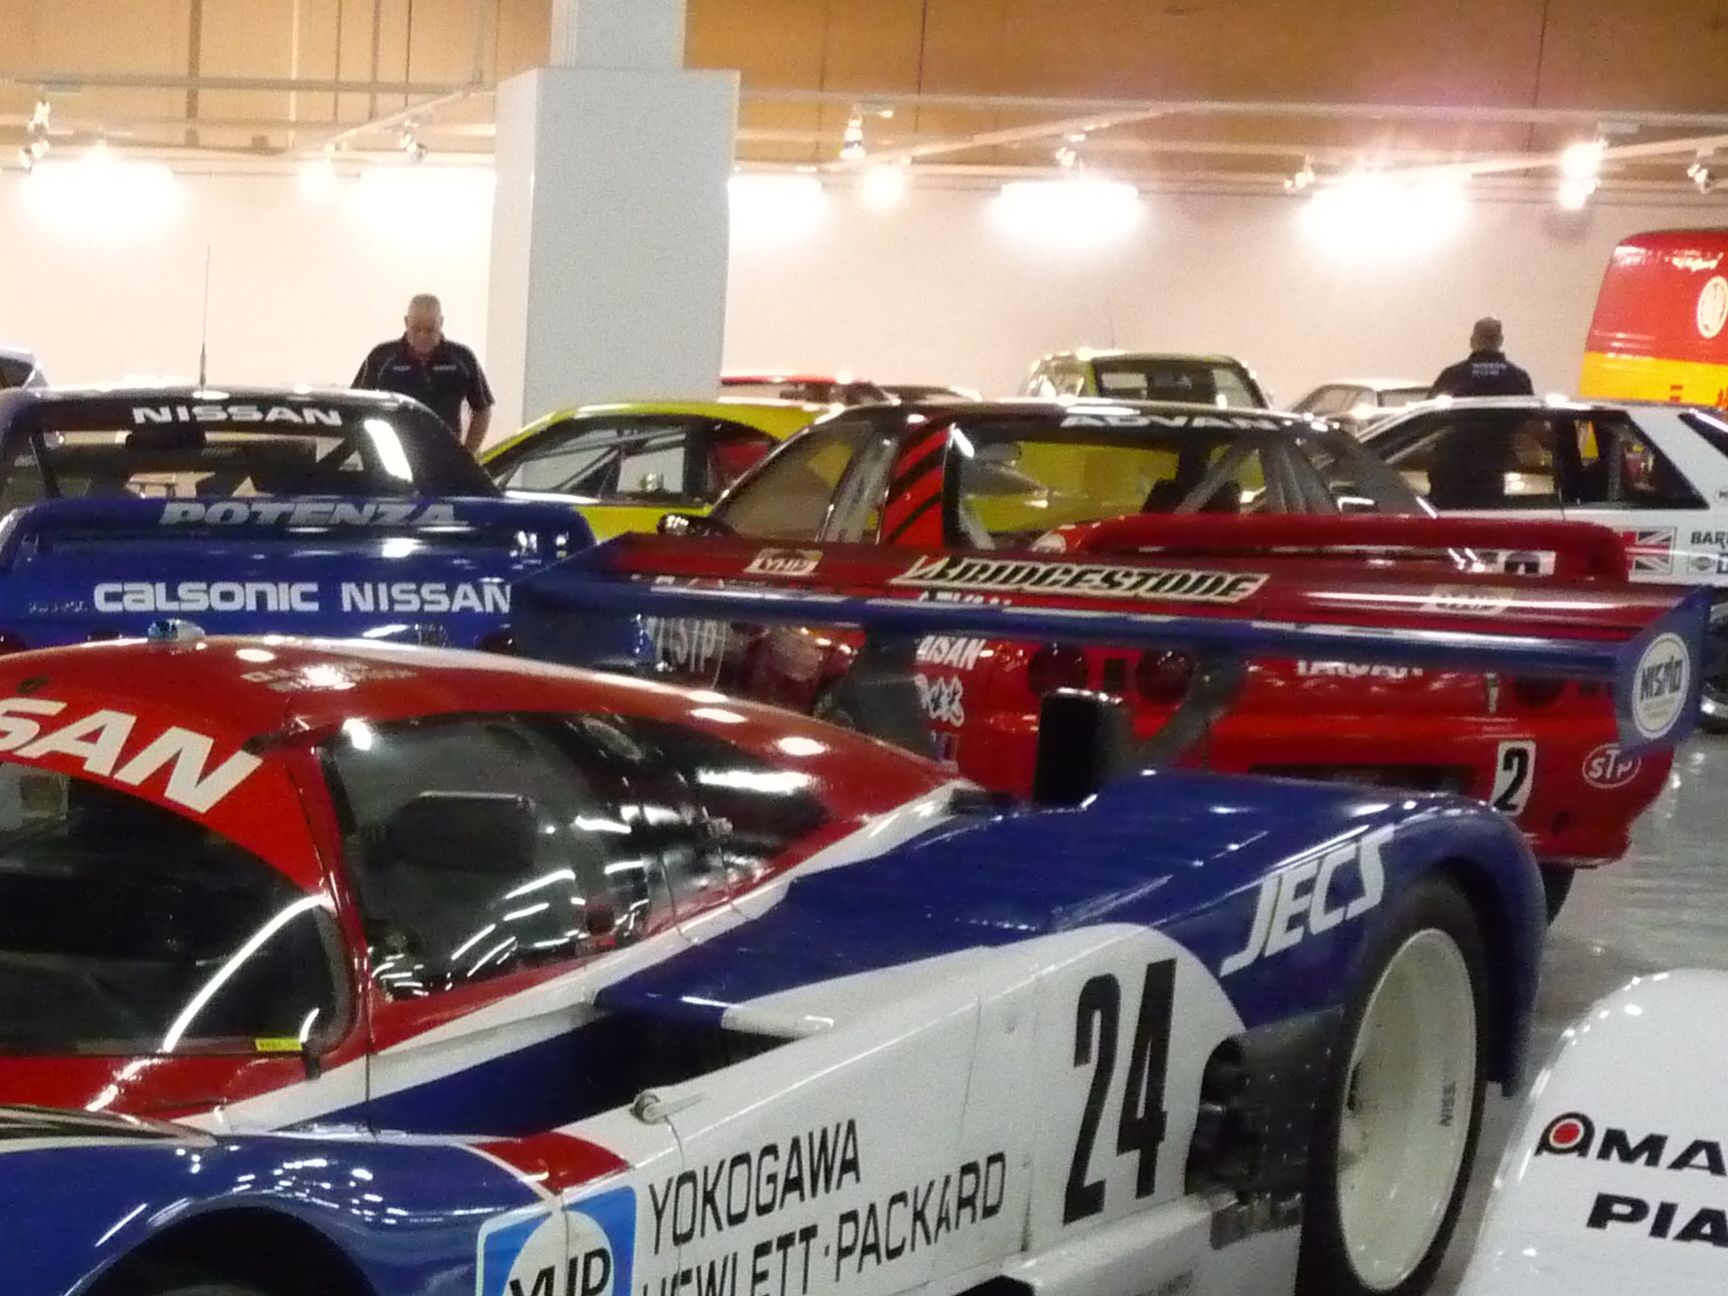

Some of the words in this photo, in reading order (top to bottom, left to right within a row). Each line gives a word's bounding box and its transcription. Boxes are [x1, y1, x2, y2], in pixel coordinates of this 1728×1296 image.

[132, 405, 343, 427] NISSAN
[158, 503, 469, 527] POTENZA
[341, 581, 512, 614] NISSAN
[894, 556, 1267, 601] BRIDGESTONE
[1494, 747, 1530, 813] 2
[1219, 823, 1396, 978] JECS
[1061, 958, 1178, 1227] 24
[648, 1118, 862, 1255] YOKOGAWA
